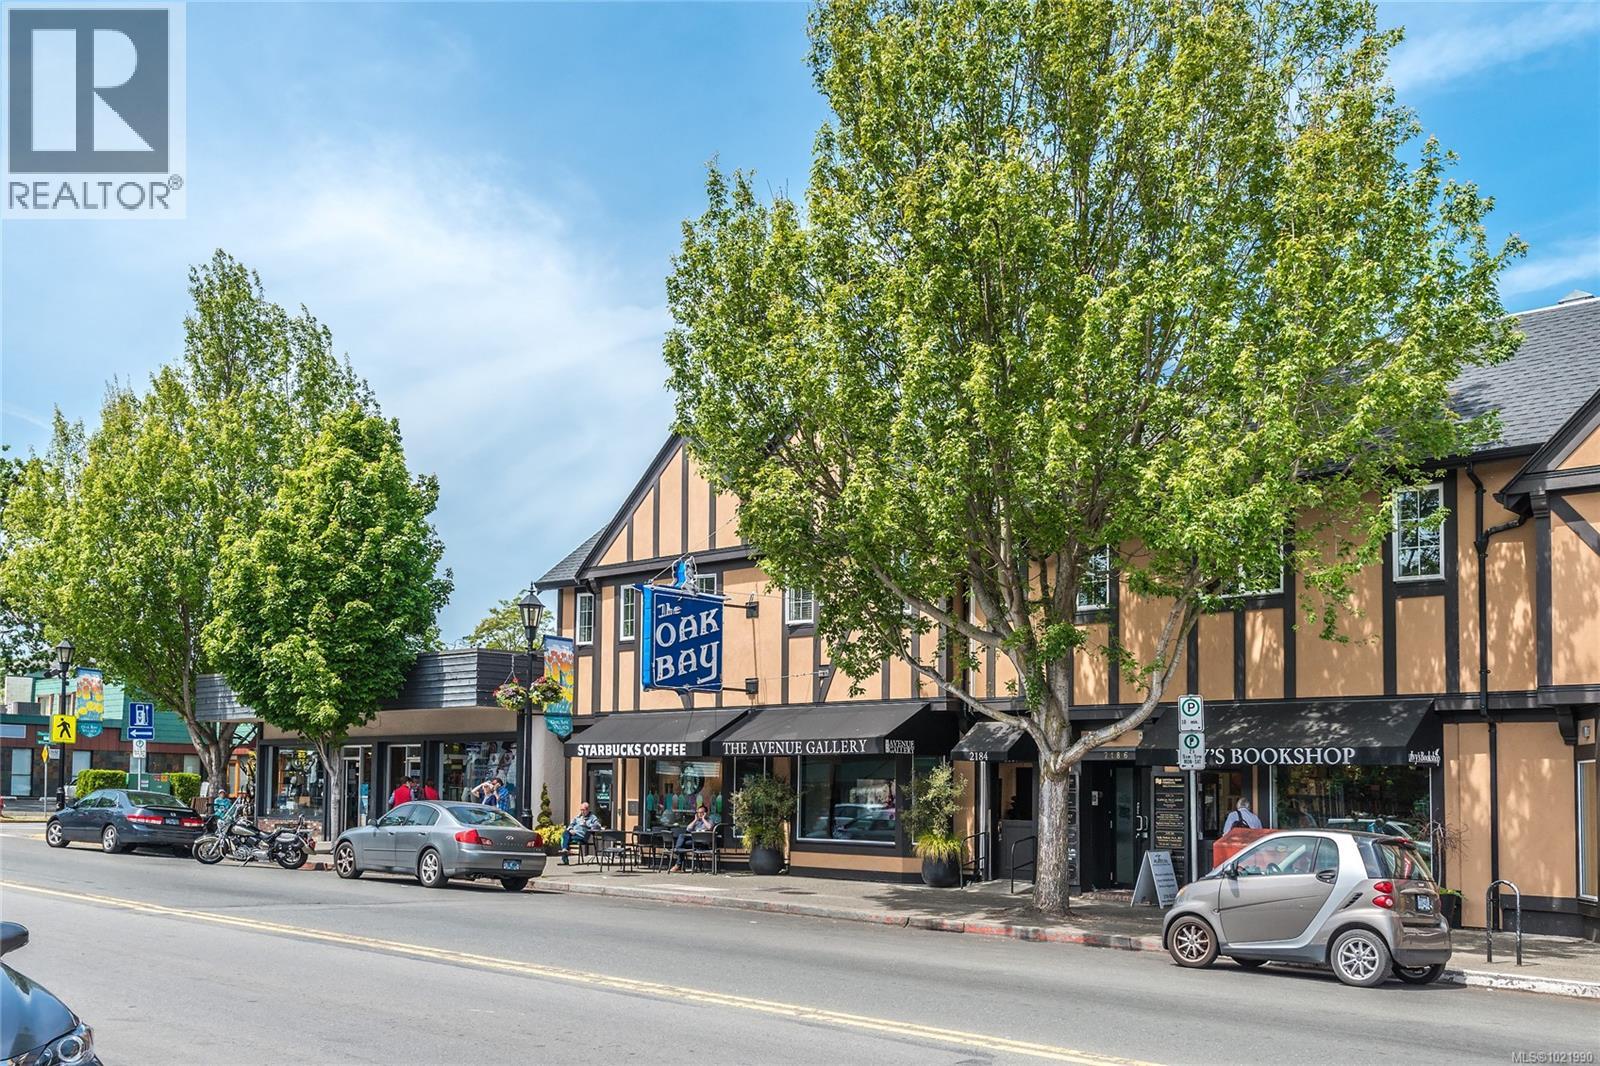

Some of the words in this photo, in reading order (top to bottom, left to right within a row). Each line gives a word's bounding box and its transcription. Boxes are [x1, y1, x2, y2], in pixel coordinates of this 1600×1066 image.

[657, 602, 682, 618] The
[656, 608, 720, 648] OAK
[655, 641, 720, 684] BAY
[577, 743, 641, 756] STARBUCKS
[643, 743, 687, 756] COFFEE
[722, 742, 748, 755] THE
[751, 741, 803, 754] AVENUE
[805, 739, 868, 755] GALLERY
[969, 751, 989, 761] 2184
[1230, 747, 1356, 765] BOOKSHOP
